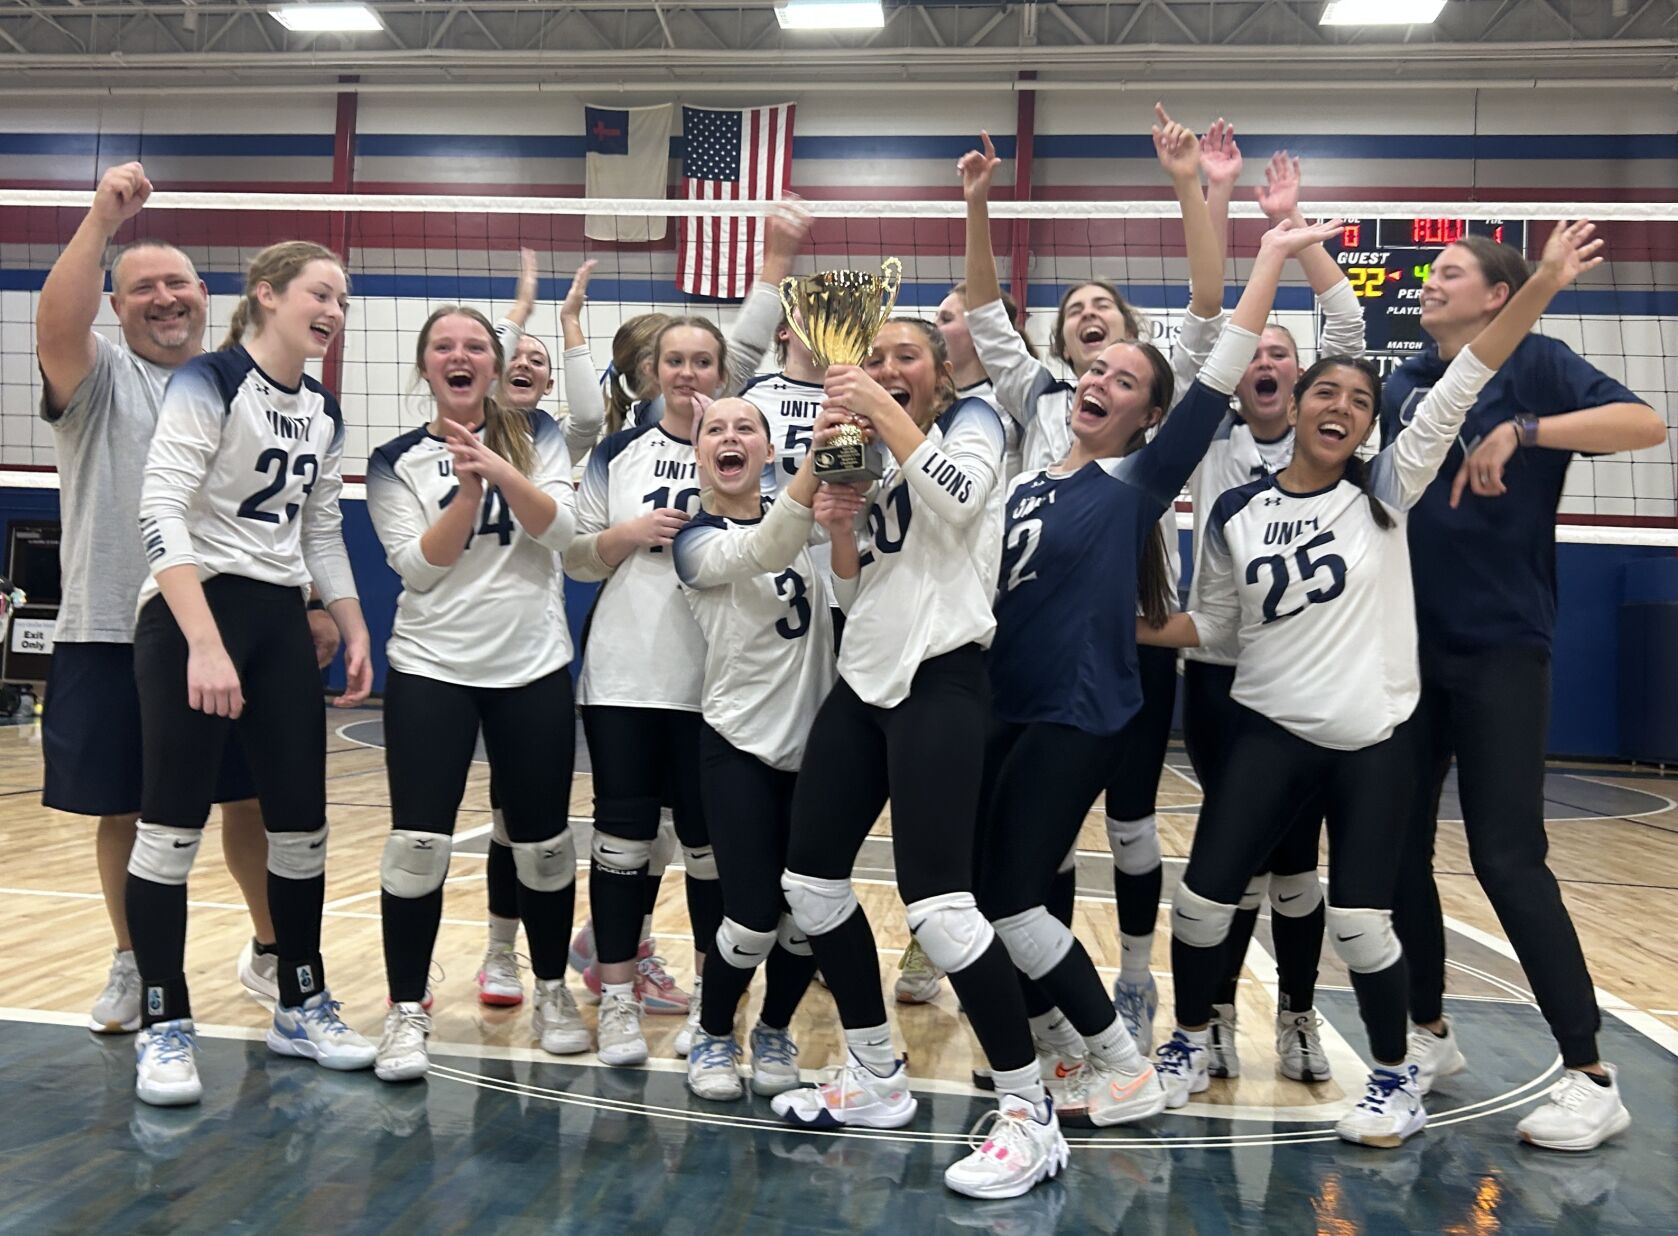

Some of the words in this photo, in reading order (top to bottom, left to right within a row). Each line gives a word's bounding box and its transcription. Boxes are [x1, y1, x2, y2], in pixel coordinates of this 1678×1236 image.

[1337, 252, 1391, 265] GUEST
[1348, 267, 1386, 297] 22
[1387, 306, 1424, 315] PLAYE
[1387, 341, 1424, 350] MATCH
[780, 400, 821, 418] UNIT
[782, 424, 814, 476] 5
[654, 459, 697, 480] UNIT
[921, 452, 972, 504] LIONS
[236, 448, 319, 525] 23
[1007, 518, 1043, 593] 2
[1246, 530, 1348, 625] 25
[774, 567, 812, 640] 3
[21, 640, 45, 651] Only
[24, 630, 44, 639] Exit
